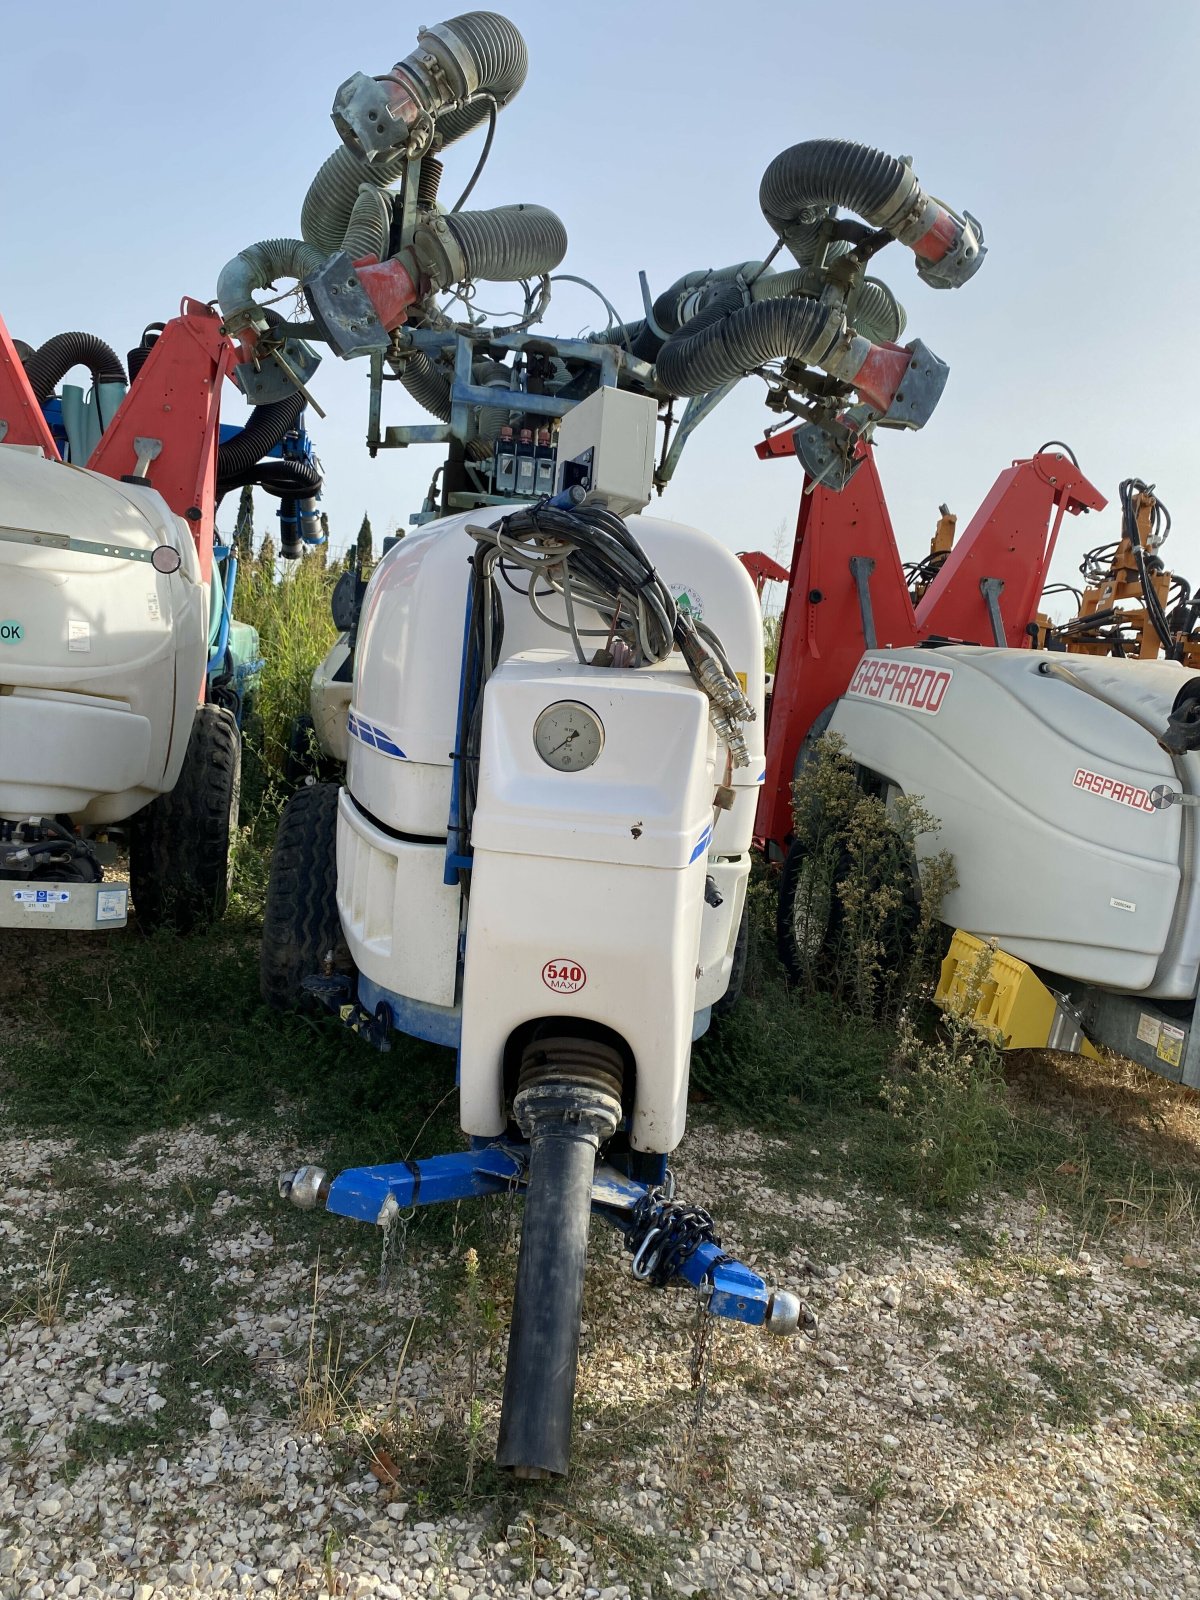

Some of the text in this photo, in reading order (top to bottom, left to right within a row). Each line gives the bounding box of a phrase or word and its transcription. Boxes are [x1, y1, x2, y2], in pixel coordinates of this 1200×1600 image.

[0, 625, 21, 639] OK
[850, 660, 950, 712] GASPARDO
[547, 964, 582, 982] 540
[550, 980, 577, 990] MAXI
